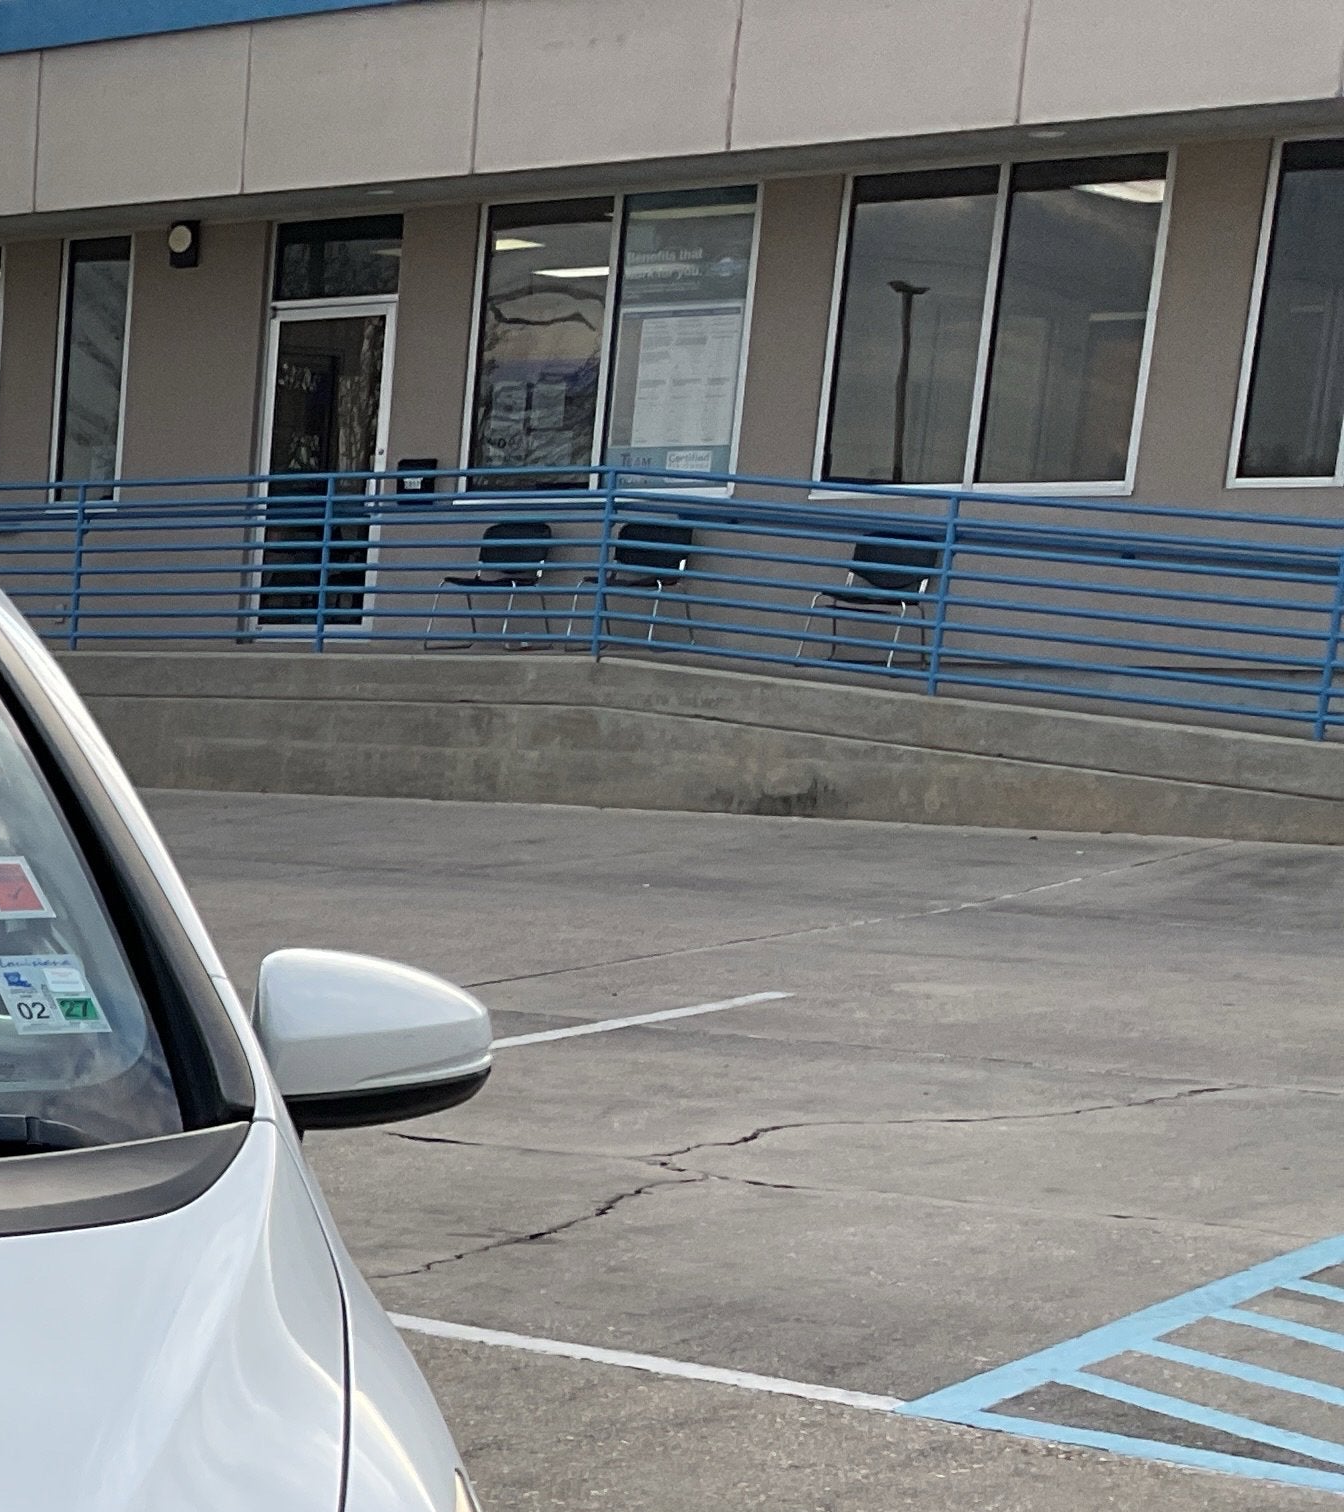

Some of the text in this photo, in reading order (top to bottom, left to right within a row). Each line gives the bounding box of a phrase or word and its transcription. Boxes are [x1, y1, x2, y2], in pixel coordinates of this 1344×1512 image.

[626, 247, 703, 264] Benefits that
[17, 1001, 50, 1020] 02
[59, 1000, 89, 1018] 27
